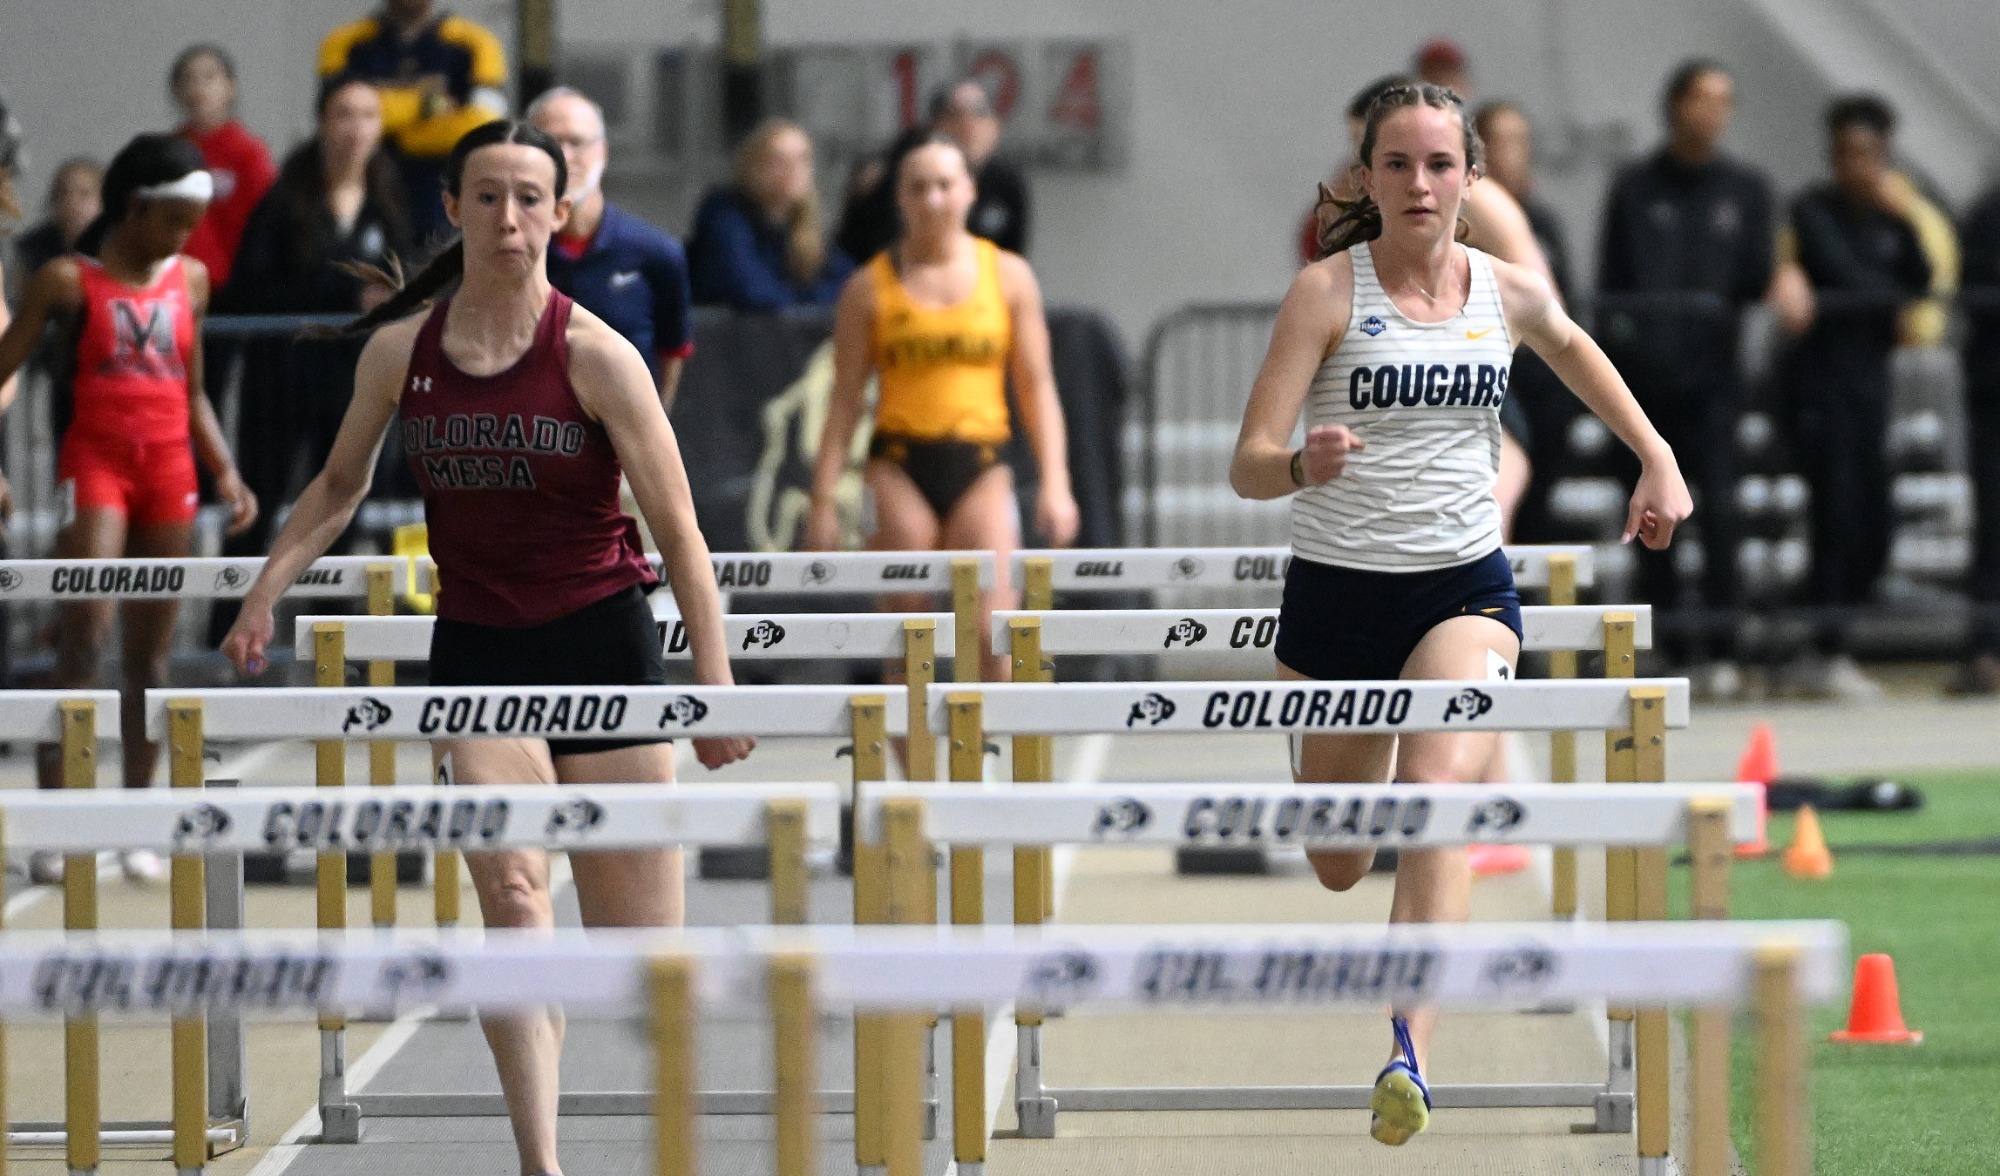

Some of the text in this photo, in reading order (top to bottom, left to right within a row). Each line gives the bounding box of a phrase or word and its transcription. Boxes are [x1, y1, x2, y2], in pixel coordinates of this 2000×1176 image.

[1350, 364, 1508, 410] COUGARS
[401, 413, 585, 457] OLORADO
[422, 455, 537, 490] MESA
[52, 565, 186, 593] COLORADO
[881, 563, 931, 580] GILL
[1075, 560, 1125, 577] GILL
[419, 694, 628, 734] COLORADO
[1202, 688, 1413, 728] COLORADO
